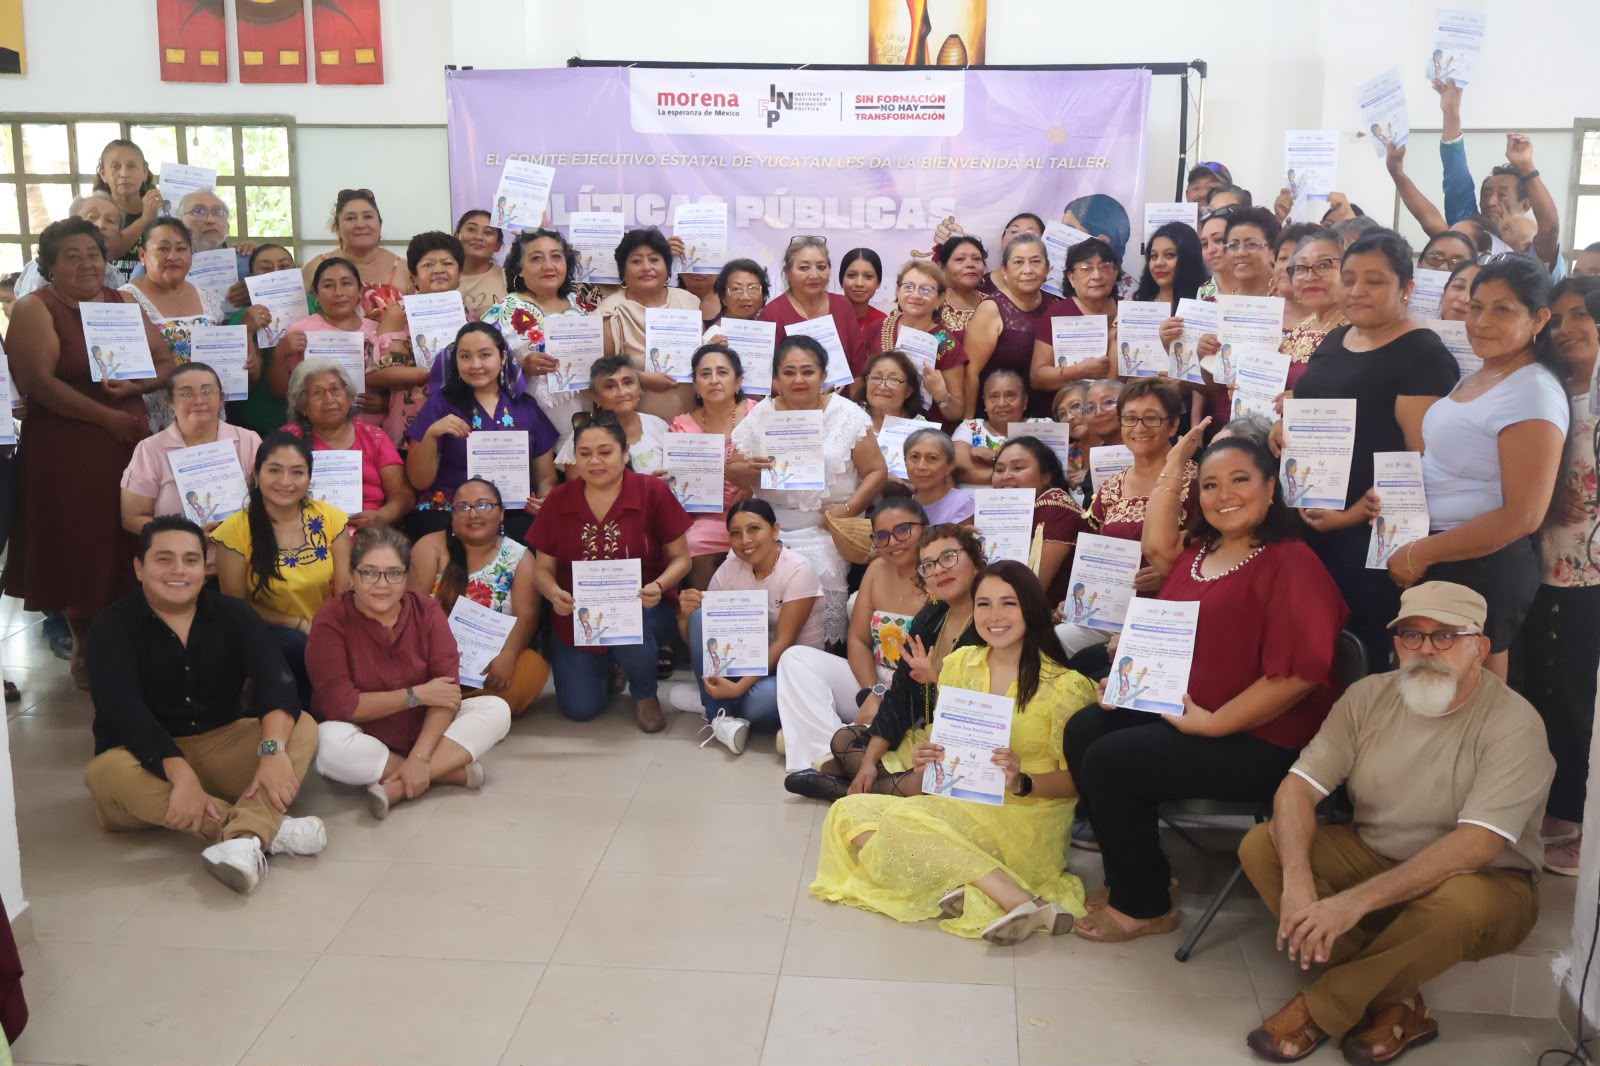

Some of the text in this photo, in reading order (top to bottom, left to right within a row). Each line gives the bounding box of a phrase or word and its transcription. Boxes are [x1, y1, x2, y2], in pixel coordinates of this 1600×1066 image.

[657, 92, 740, 108] morena
[855, 93, 946, 104] SIN FORMACIÓN
[880, 104, 920, 112] NO HAY
[667, 109, 702, 118] esperanza
[714, 109, 740, 117] México
[855, 111, 946, 121] TRANSFORMACIÓN
[485, 153, 503, 166] EL
[571, 152, 657, 167] EJECUTIVO
[660, 153, 728, 168] ESTATAL
[731, 154, 753, 168] DE
[837, 156, 866, 169] LES
[869, 156, 893, 169] DA
[896, 156, 917, 169] LA
[920, 156, 1020, 170] BIENVENIDA
[1023, 157, 1045, 170] AL
